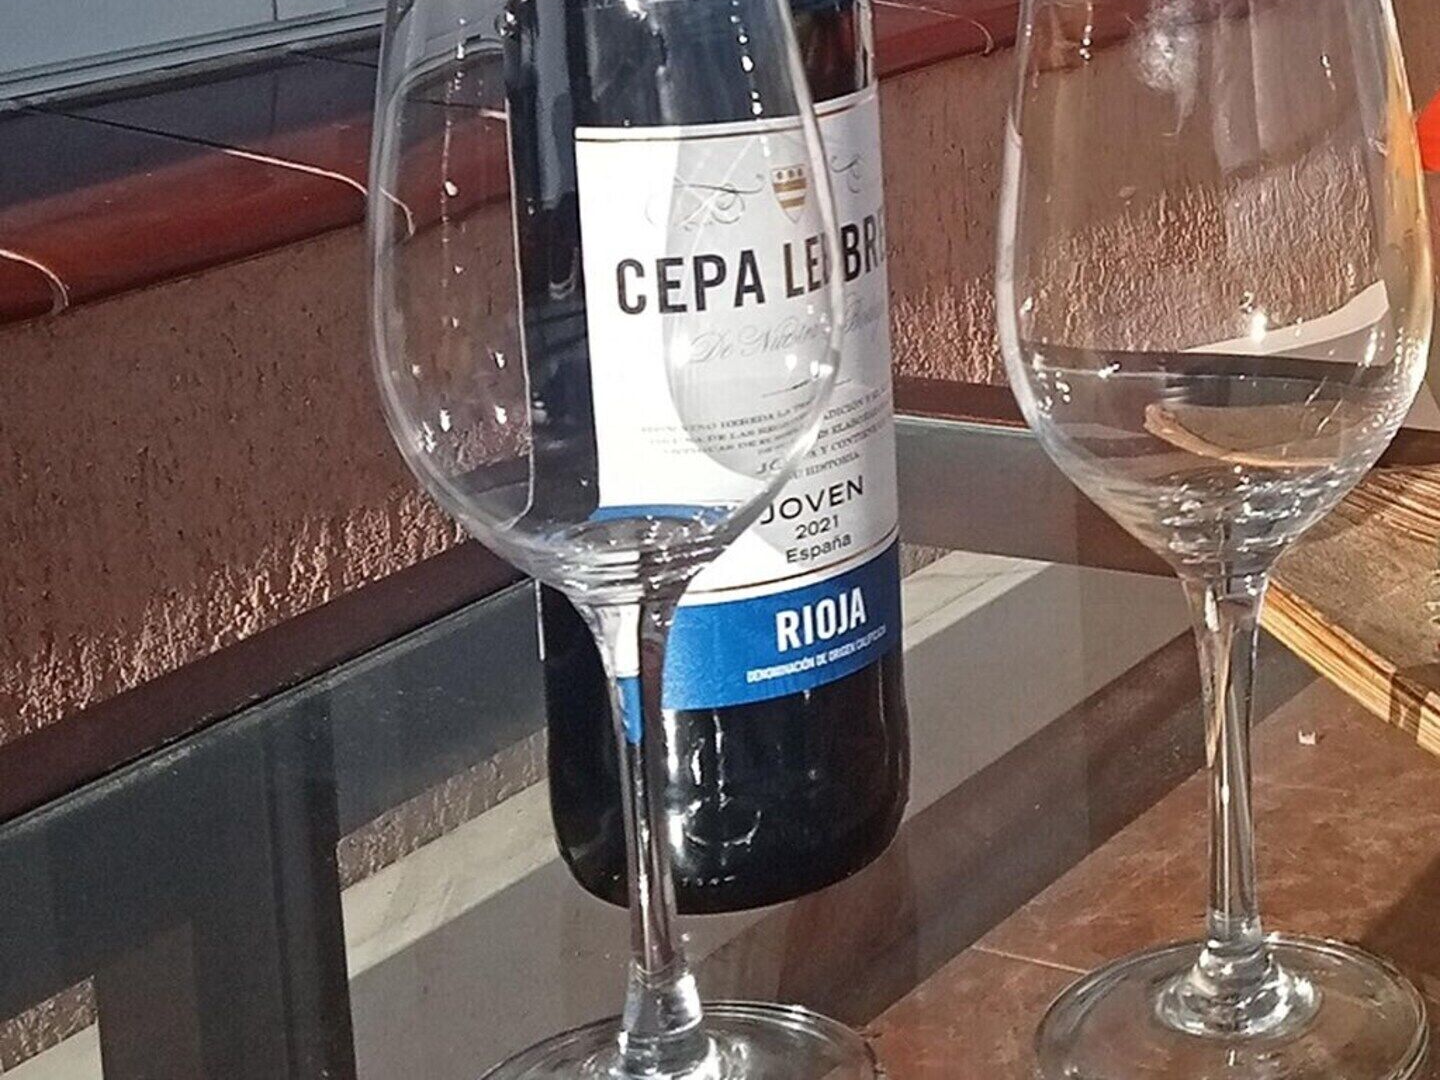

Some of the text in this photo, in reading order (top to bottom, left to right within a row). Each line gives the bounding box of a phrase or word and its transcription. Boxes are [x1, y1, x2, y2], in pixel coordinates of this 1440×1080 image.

[616, 248, 765, 315] CEPA
[760, 475, 864, 525] JOVEN
[786, 532, 853, 564] España
[795, 513, 840, 540] 2021
[774, 585, 867, 653] RIOJA
